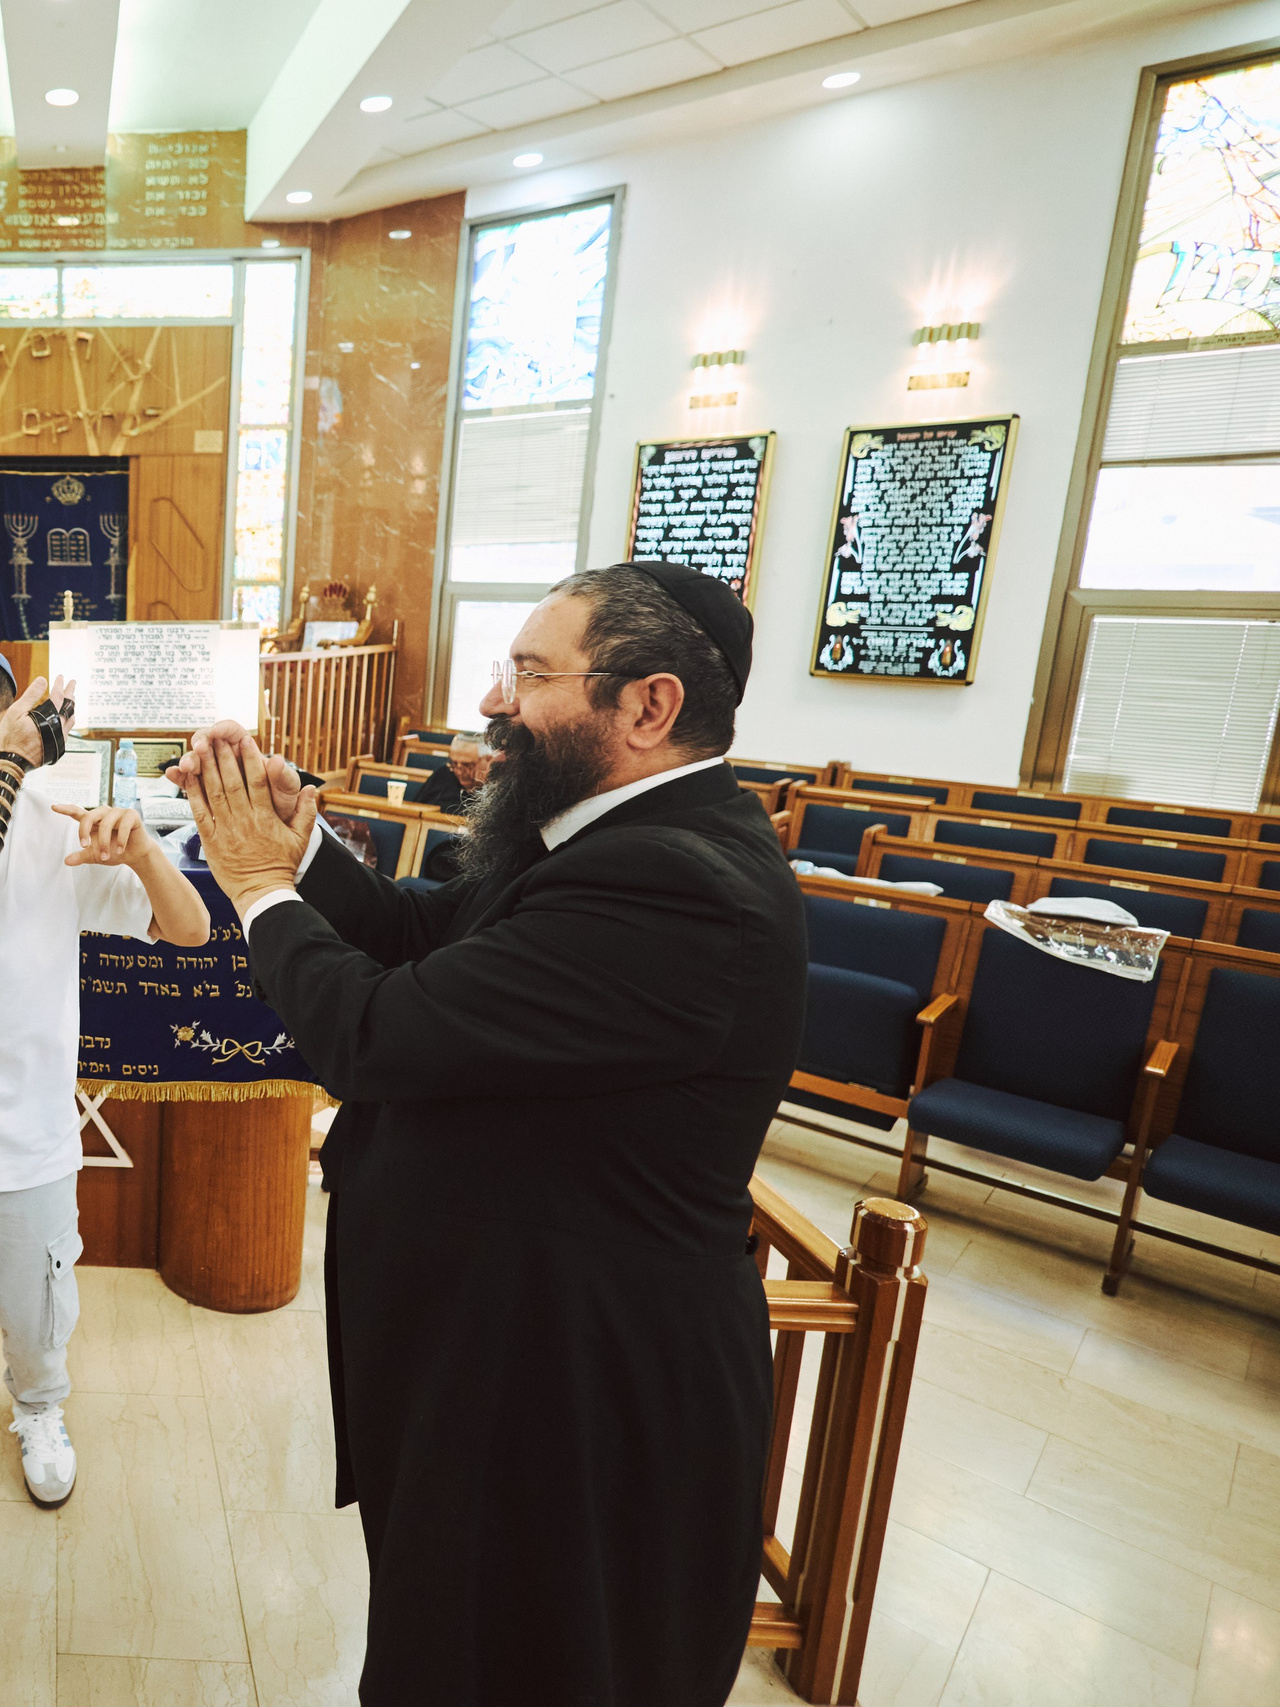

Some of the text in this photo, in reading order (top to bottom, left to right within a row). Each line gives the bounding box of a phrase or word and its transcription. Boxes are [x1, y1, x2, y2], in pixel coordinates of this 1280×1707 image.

[175, 190, 207, 201] זכור
[178, 205, 208, 217] כבד
[210, 922, 242, 942] לע"נ
[99, 952, 163, 970] ומסעודה
[176, 955, 218, 970] יהודה
[231, 954, 248, 972] בן
[122, 1064, 159, 1076] ניסים
